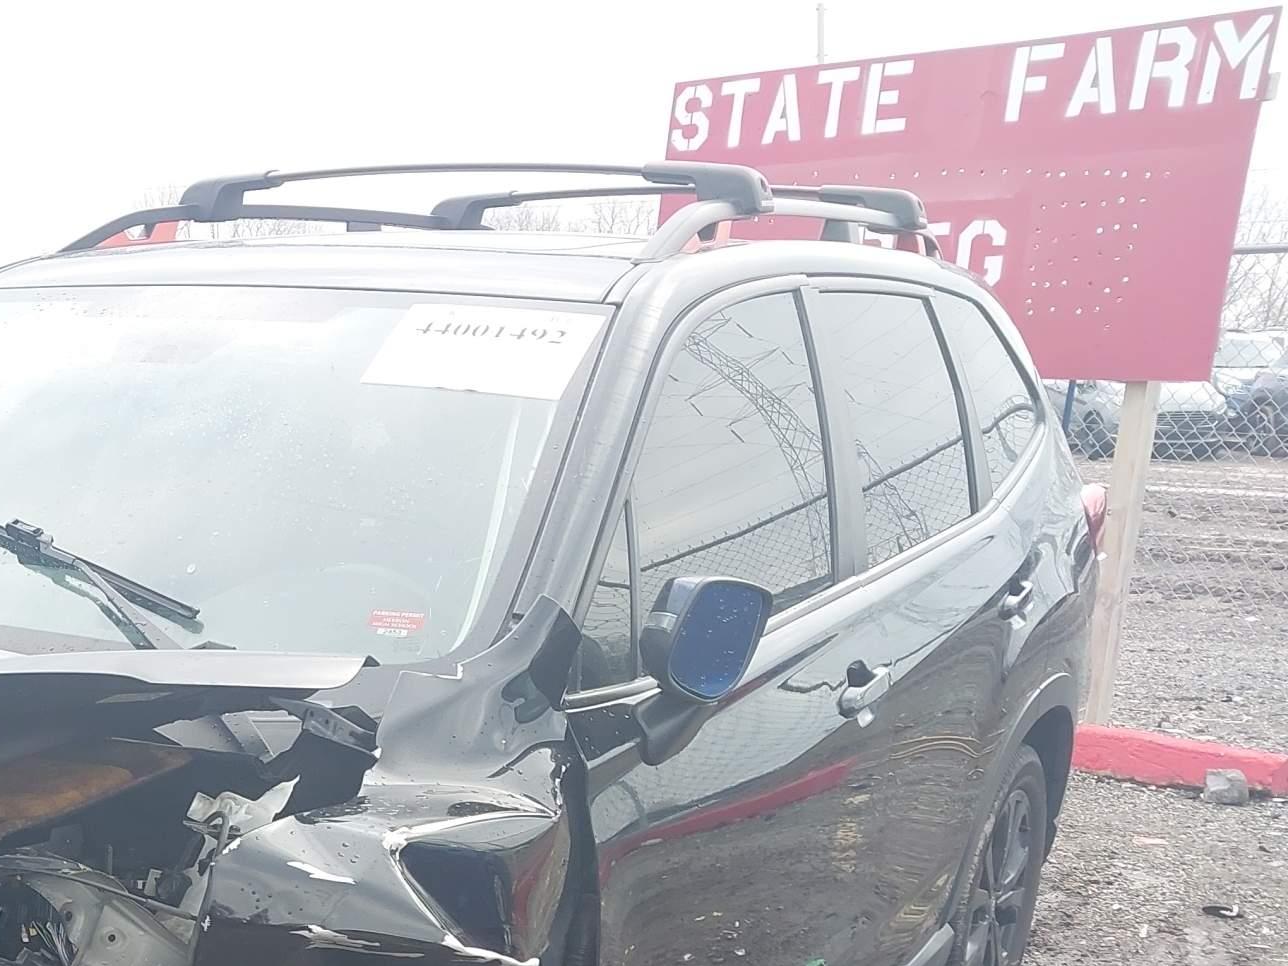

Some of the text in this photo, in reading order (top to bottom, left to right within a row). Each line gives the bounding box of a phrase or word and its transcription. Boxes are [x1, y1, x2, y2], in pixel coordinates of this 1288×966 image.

[670, 14, 1274, 152] STATE FARM
[416, 321, 567, 344] 44001492
